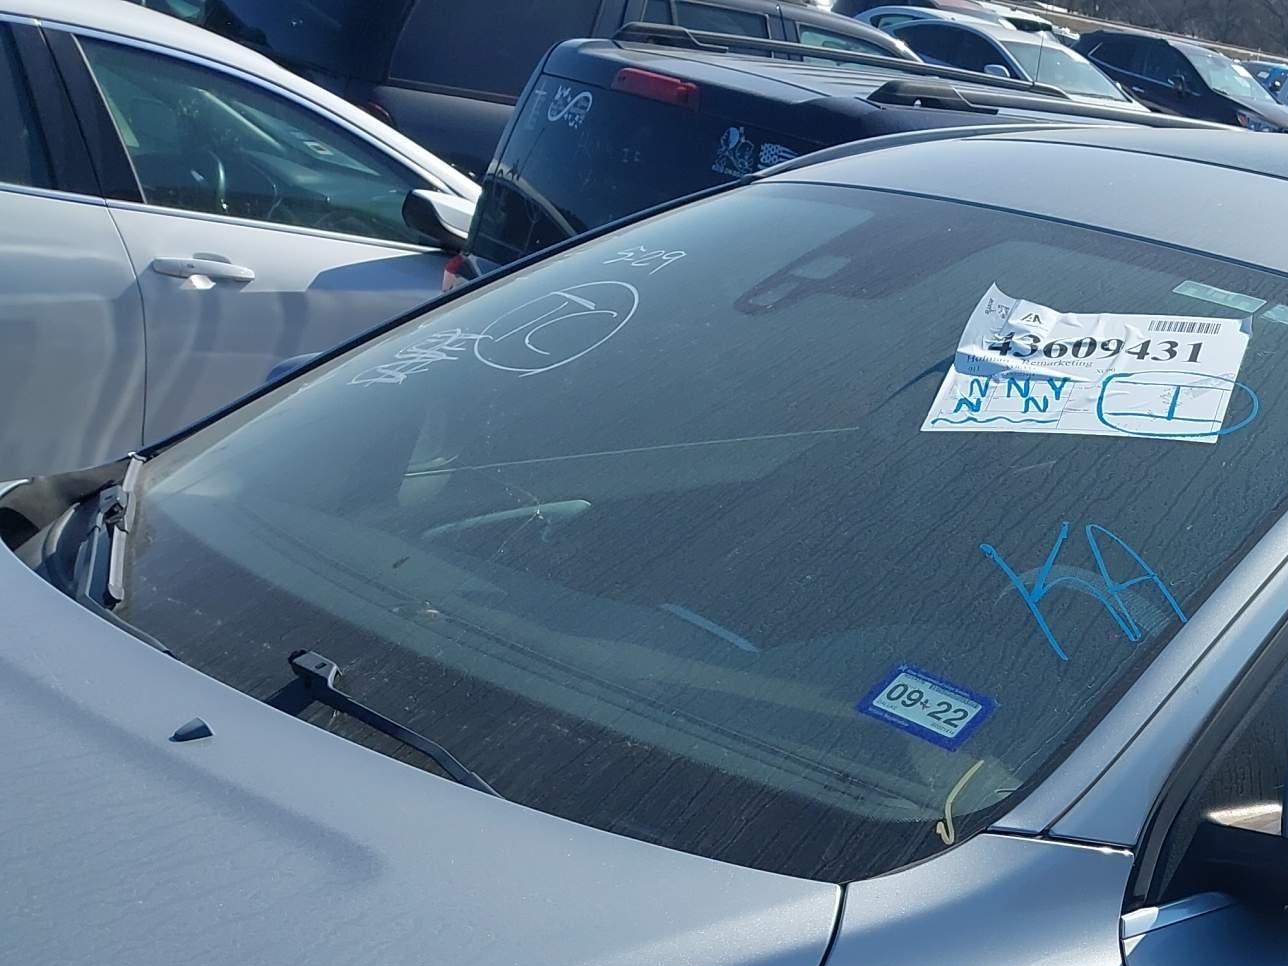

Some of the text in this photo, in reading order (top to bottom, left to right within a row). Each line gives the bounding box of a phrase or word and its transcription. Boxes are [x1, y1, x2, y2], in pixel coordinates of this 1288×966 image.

[986, 331, 1204, 364] 43609431
[886, 683, 924, 708] 09
[927, 701, 969, 729] 22
